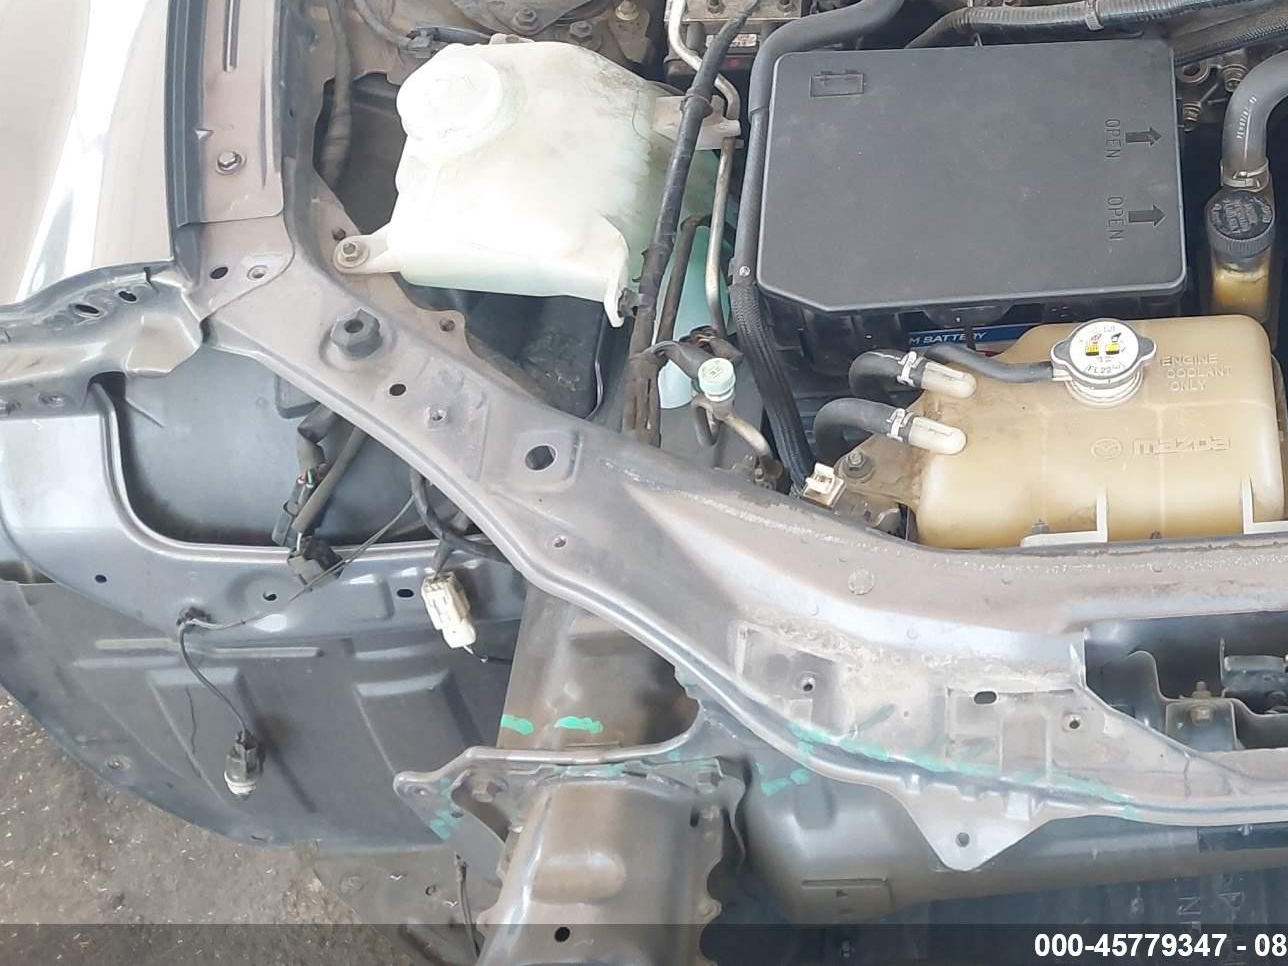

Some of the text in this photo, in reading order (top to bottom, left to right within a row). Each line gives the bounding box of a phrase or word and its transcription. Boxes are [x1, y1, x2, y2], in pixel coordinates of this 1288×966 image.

[1105, 118, 1122, 160] OPEN
[1107, 196, 1124, 241] OPEN
[1160, 354, 1218, 367] ENGINE
[1166, 365, 1232, 379] COOLANT
[1170, 379, 1206, 392] ONLY
